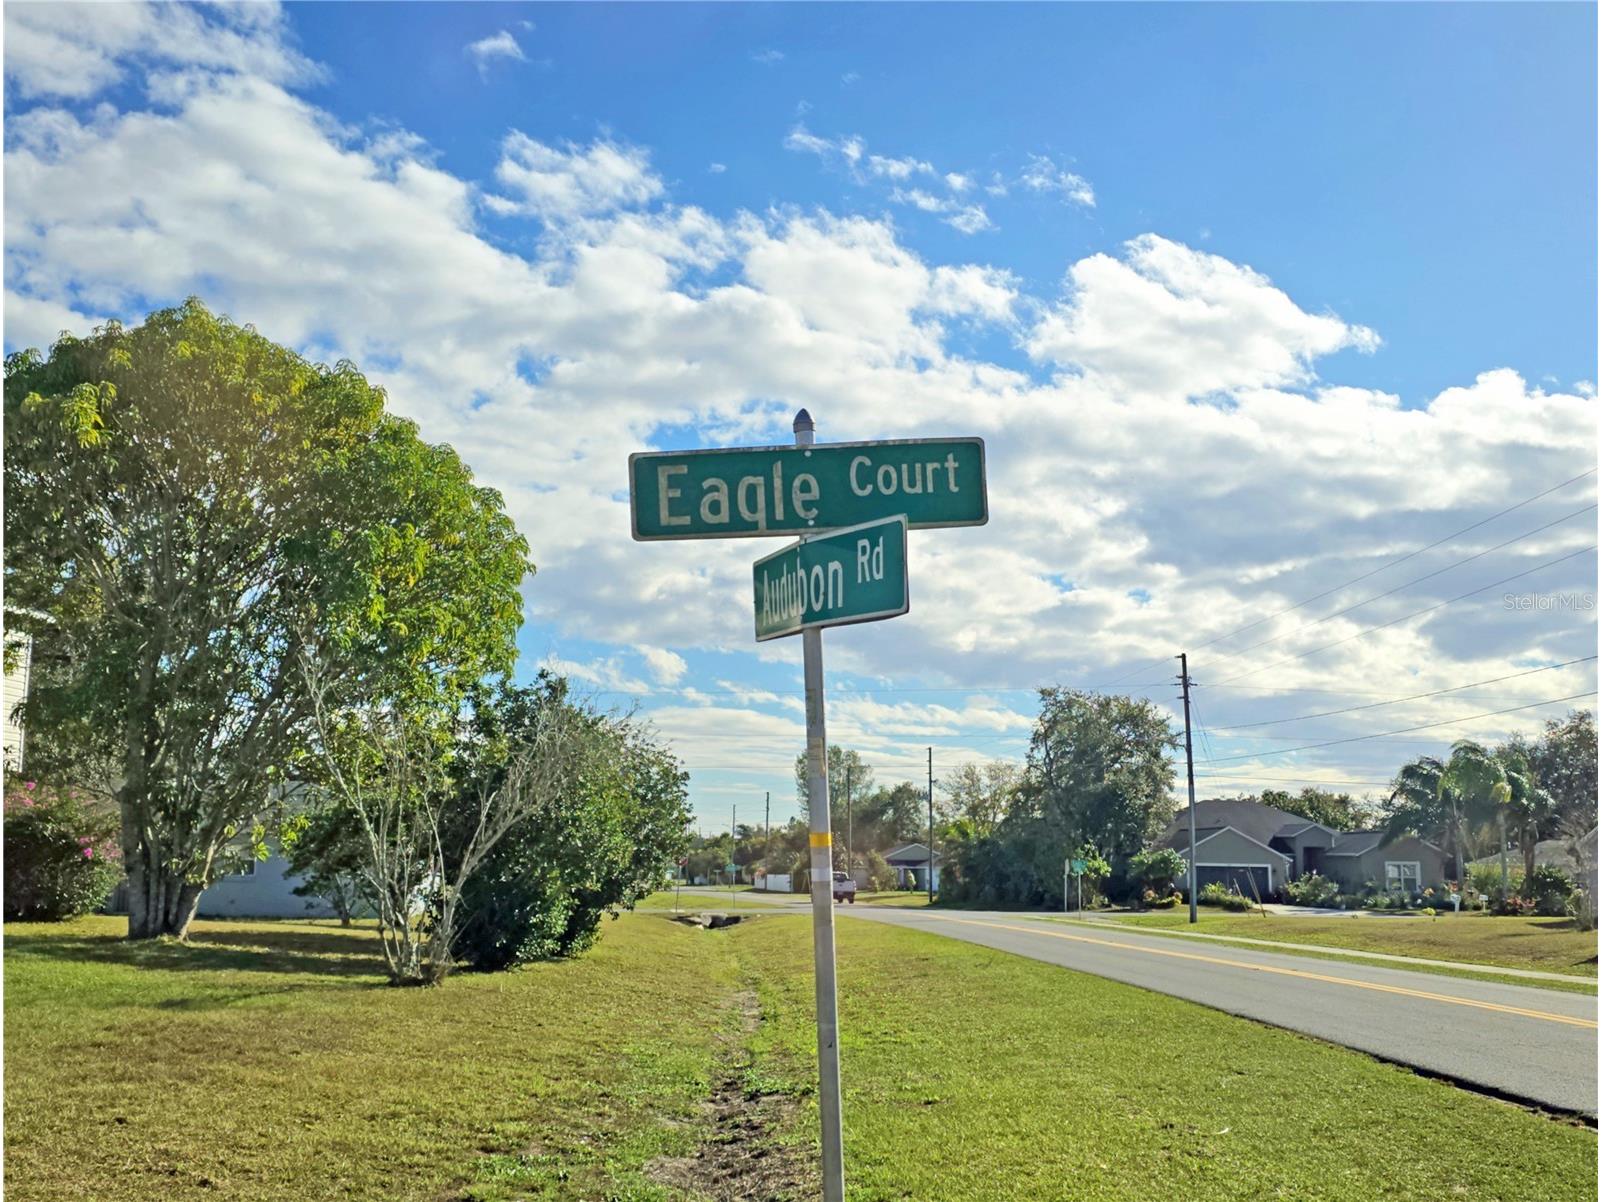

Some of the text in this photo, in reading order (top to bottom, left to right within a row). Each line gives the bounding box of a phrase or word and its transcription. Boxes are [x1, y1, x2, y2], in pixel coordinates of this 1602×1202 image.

[849, 452, 960, 497] Court
[762, 536, 885, 627] Audubon Rd
